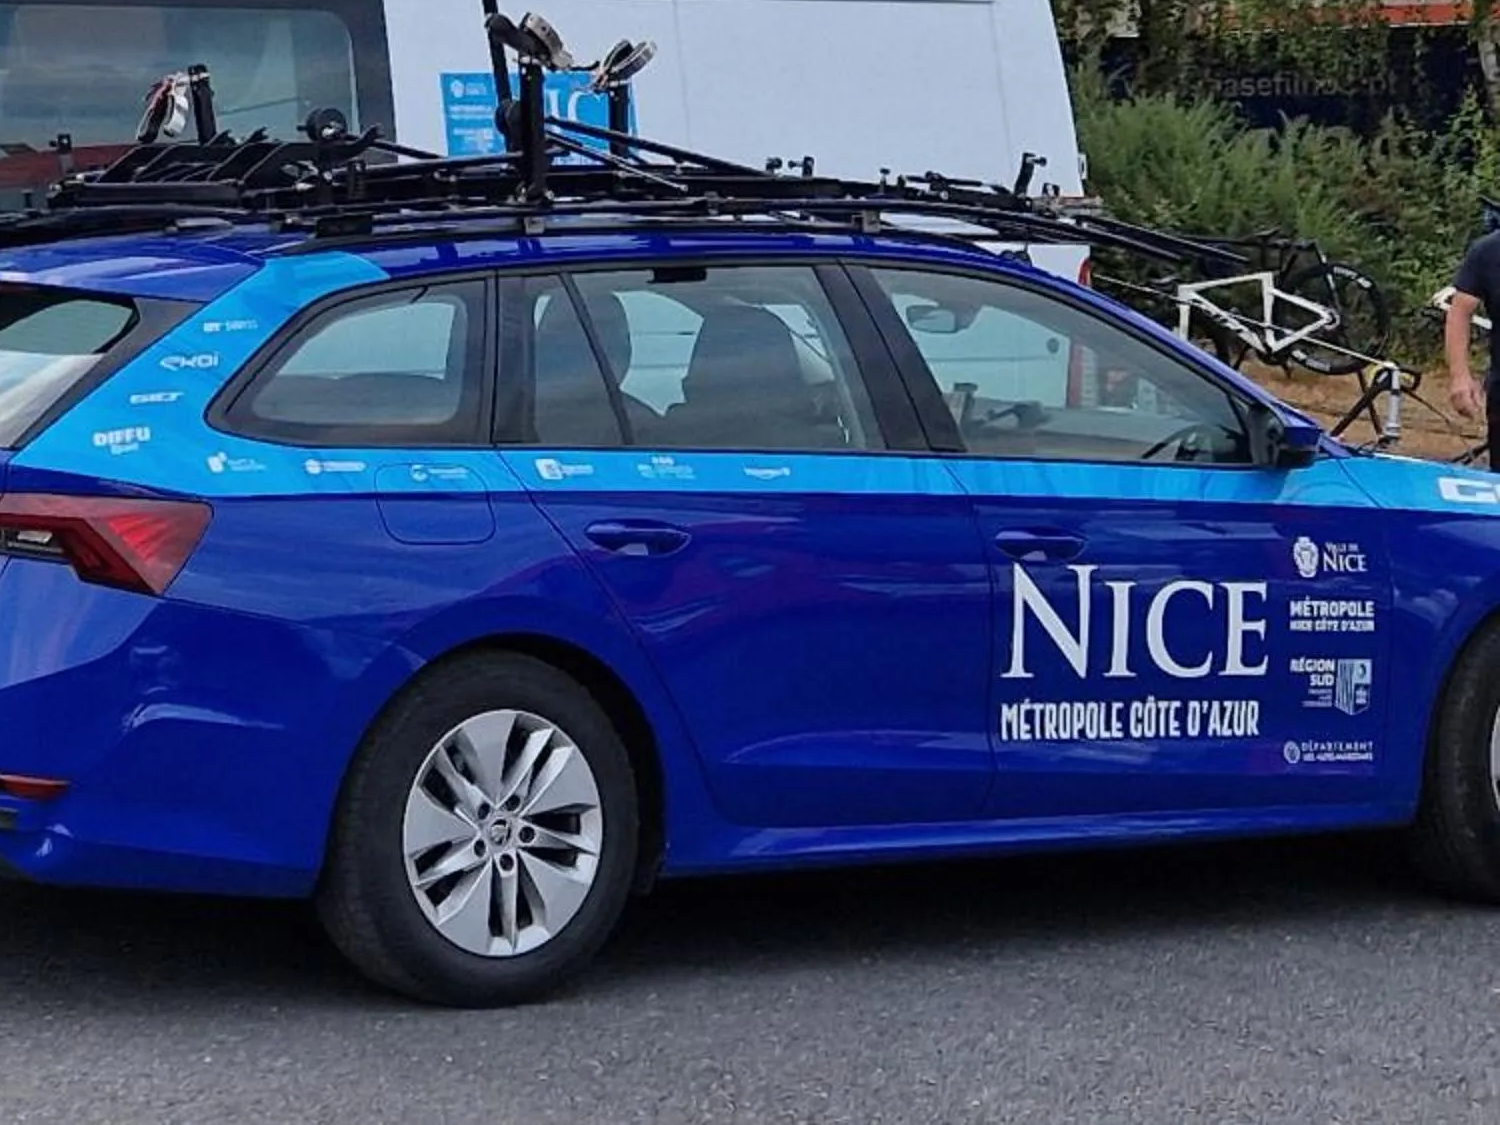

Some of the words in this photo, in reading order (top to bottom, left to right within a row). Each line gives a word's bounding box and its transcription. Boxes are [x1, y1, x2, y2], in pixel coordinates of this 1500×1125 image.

[1323, 552, 1368, 572] NICE
[1290, 595, 1376, 618] MÉTROPOLE
[1001, 562, 1269, 679] NICE
[1289, 655, 1336, 673] RÉGION
[1309, 673, 1335, 687] SUD
[1000, 698, 1125, 742] MÉTROPOLE
[1129, 695, 1182, 739] CÔTE
[1186, 699, 1261, 738] D'AZUR
